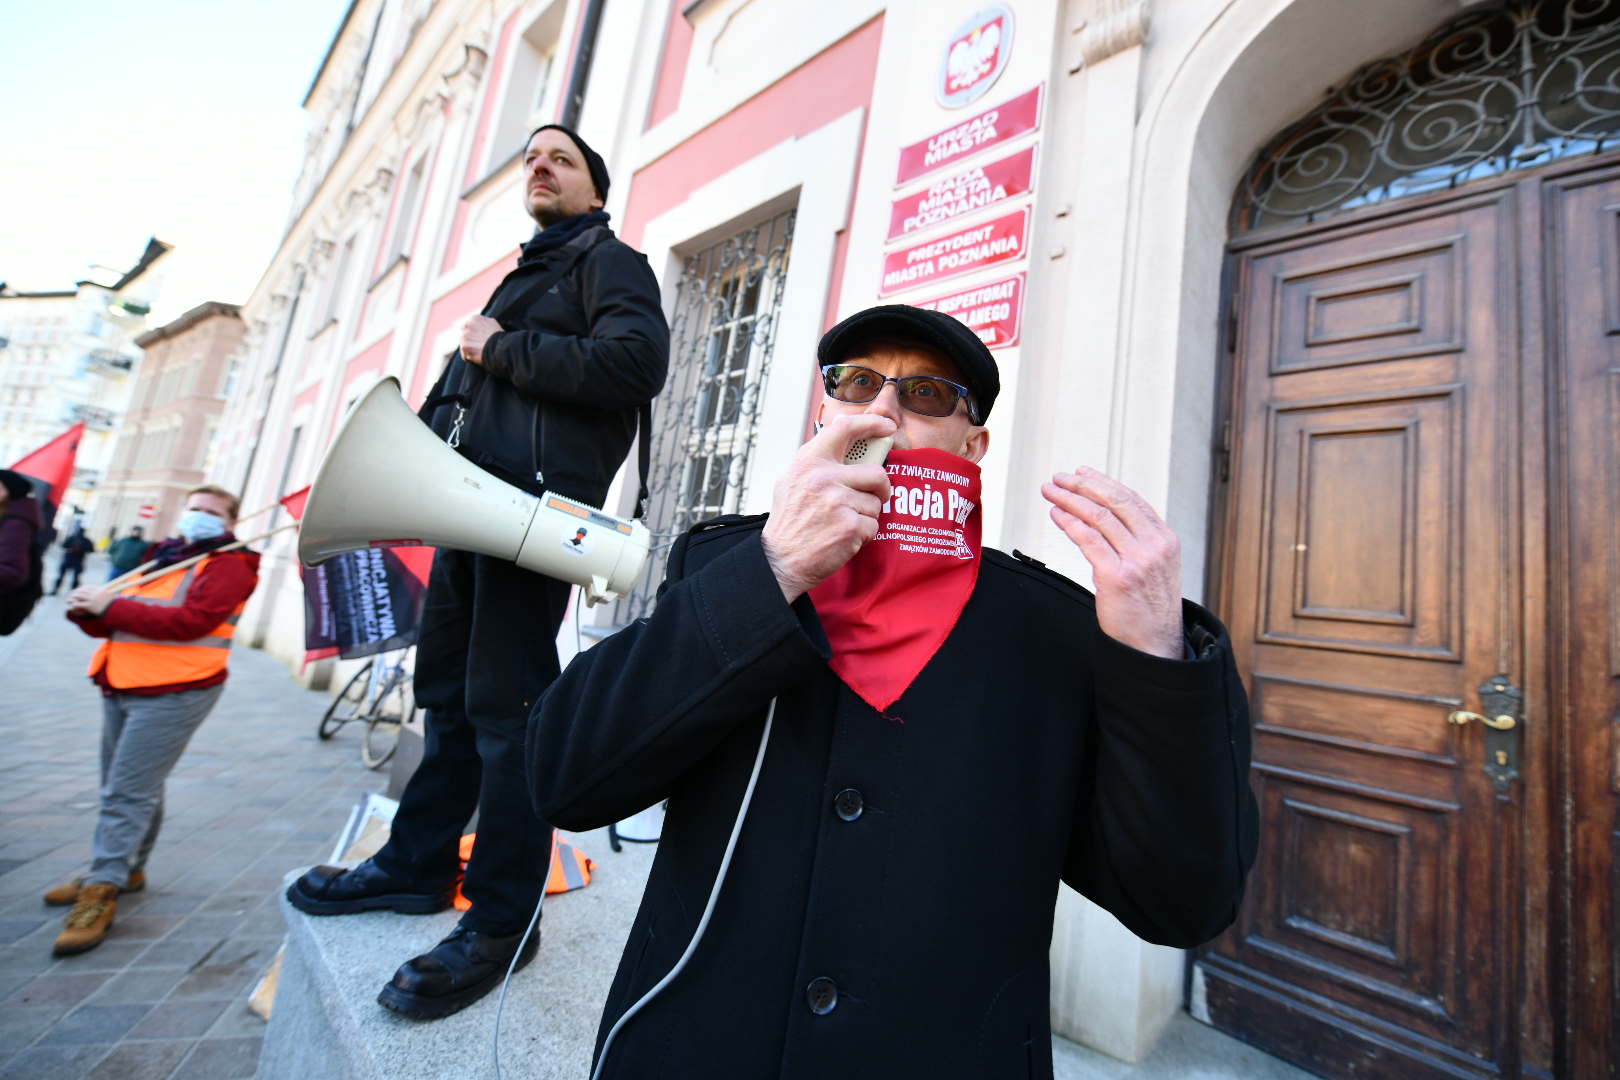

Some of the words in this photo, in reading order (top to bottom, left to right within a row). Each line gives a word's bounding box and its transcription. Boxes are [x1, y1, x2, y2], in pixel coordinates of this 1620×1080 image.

[924, 125, 998, 167] MIASTA
[918, 176, 991, 213] MIASTA
[928, 168, 985, 197] RADA
[903, 184, 1008, 232] POZNANIA
[884, 260, 935, 287] MIASTA
[938, 235, 1019, 272] POZNANIA
[906, 225, 994, 264] PREZYDENT
[937, 281, 1016, 312] INSPEKTORAT
[901, 465, 936, 480] ZWIĄZEK
[548, 498, 590, 519] WIRELESS
[886, 523, 928, 534] ORGANIZACJA
[354, 549, 380, 645] PRACOWNICZA
[368, 547, 398, 641] INICJATYWA
